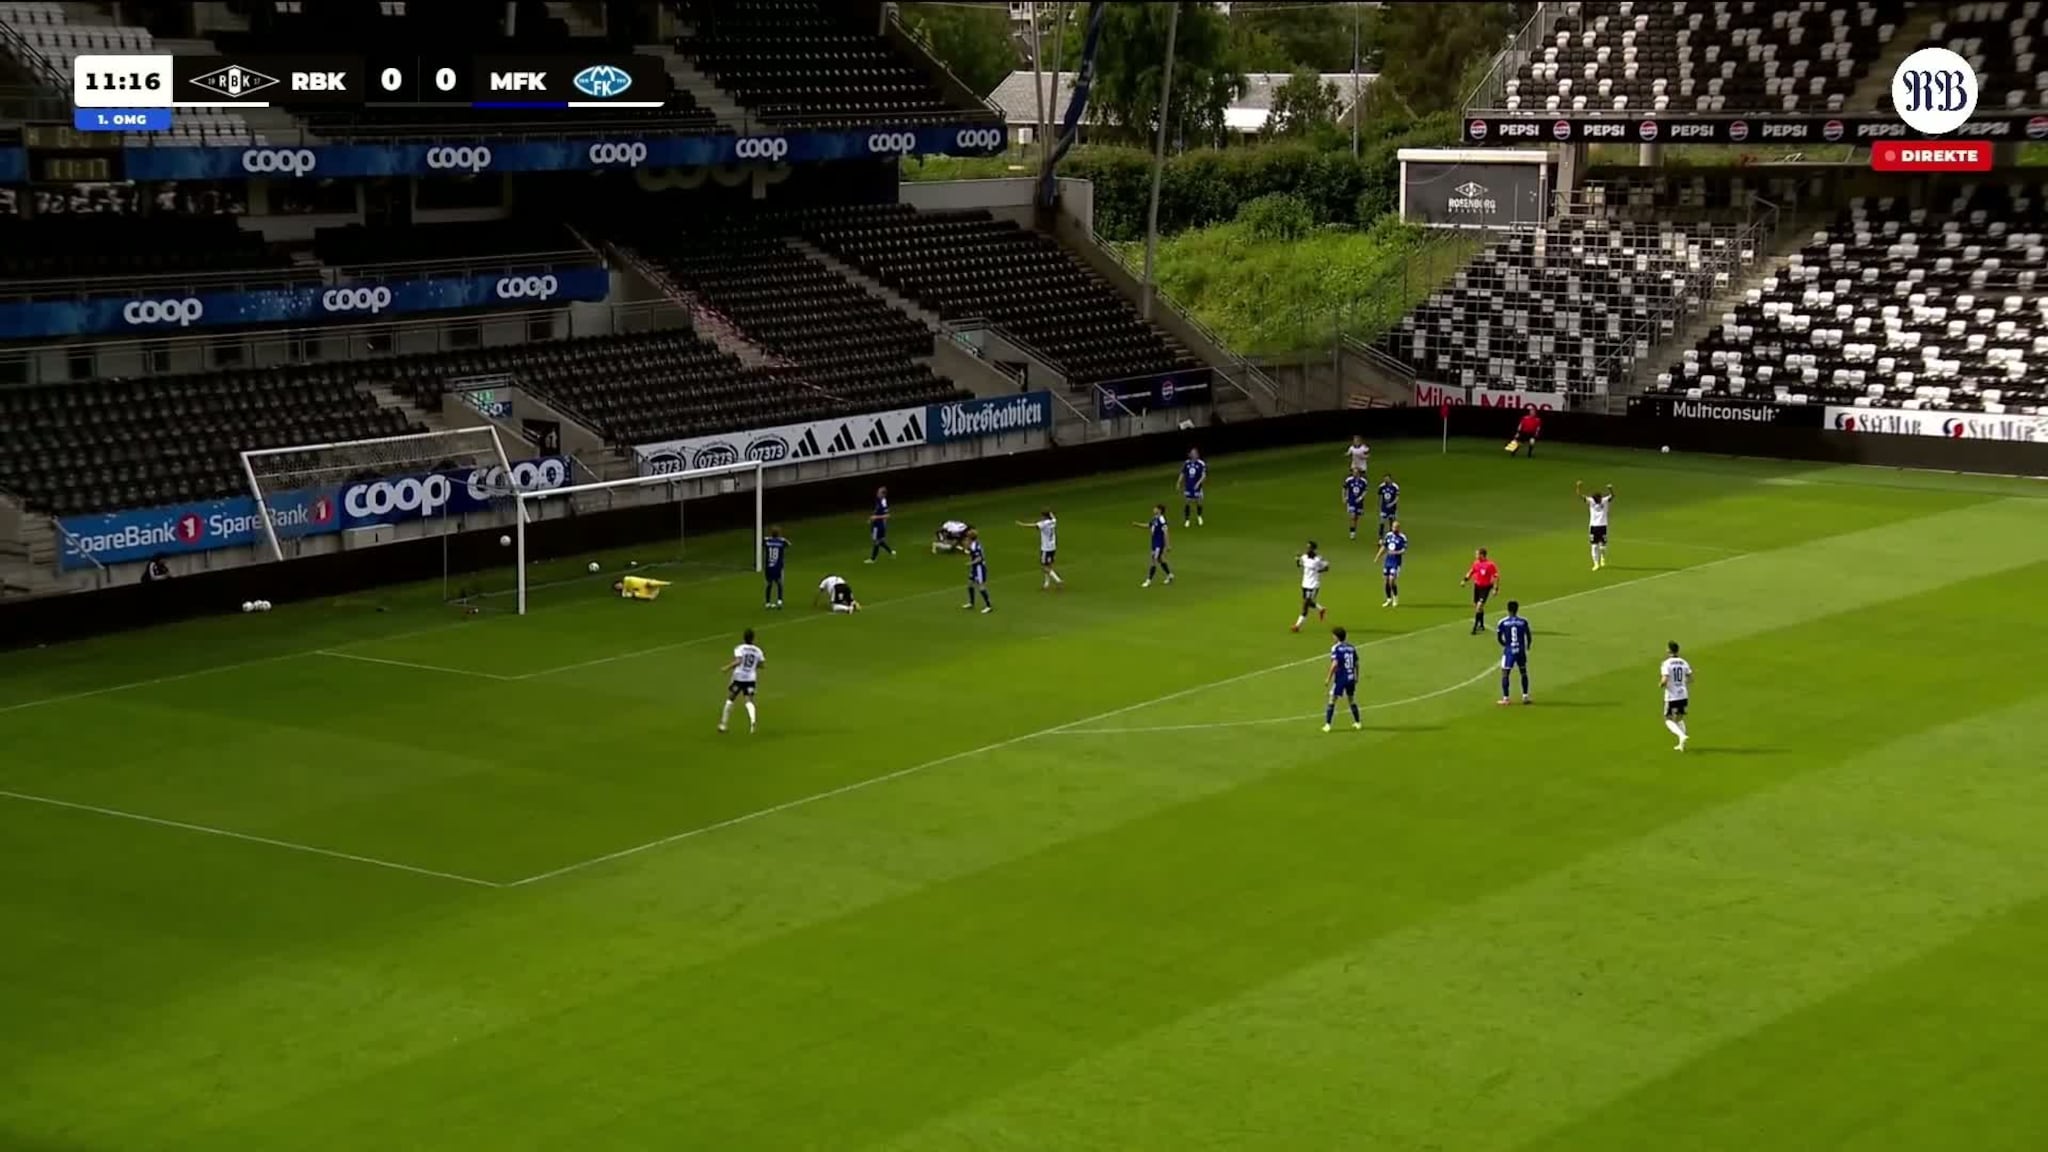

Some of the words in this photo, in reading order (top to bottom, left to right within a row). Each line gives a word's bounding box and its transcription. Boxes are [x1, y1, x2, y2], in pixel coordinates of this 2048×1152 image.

[956, 128, 1001, 150] coop
[1499, 124, 1540, 136] PEPSI
[1583, 124, 1625, 137] PEPSI
[1671, 124, 1714, 137] PEPSI
[1762, 122, 1808, 137] PEPSI
[1857, 123, 1906, 137] PEPSI
[589, 142, 647, 167] coop
[735, 137, 788, 161] coop
[867, 132, 916, 154] coop
[242, 149, 316, 177] coop
[426, 146, 491, 172] coop
[496, 275, 558, 300] coop
[322, 286, 392, 314] coop
[123, 297, 203, 327] coop
[1673, 401, 1774, 422] Multiconsult
[750, 445, 784, 461] 07373
[344, 474, 451, 518] coop
[209, 505, 309, 538] SpareBank
[66, 523, 176, 555] SpareBank
[1673, 667, 1683, 682] 10
